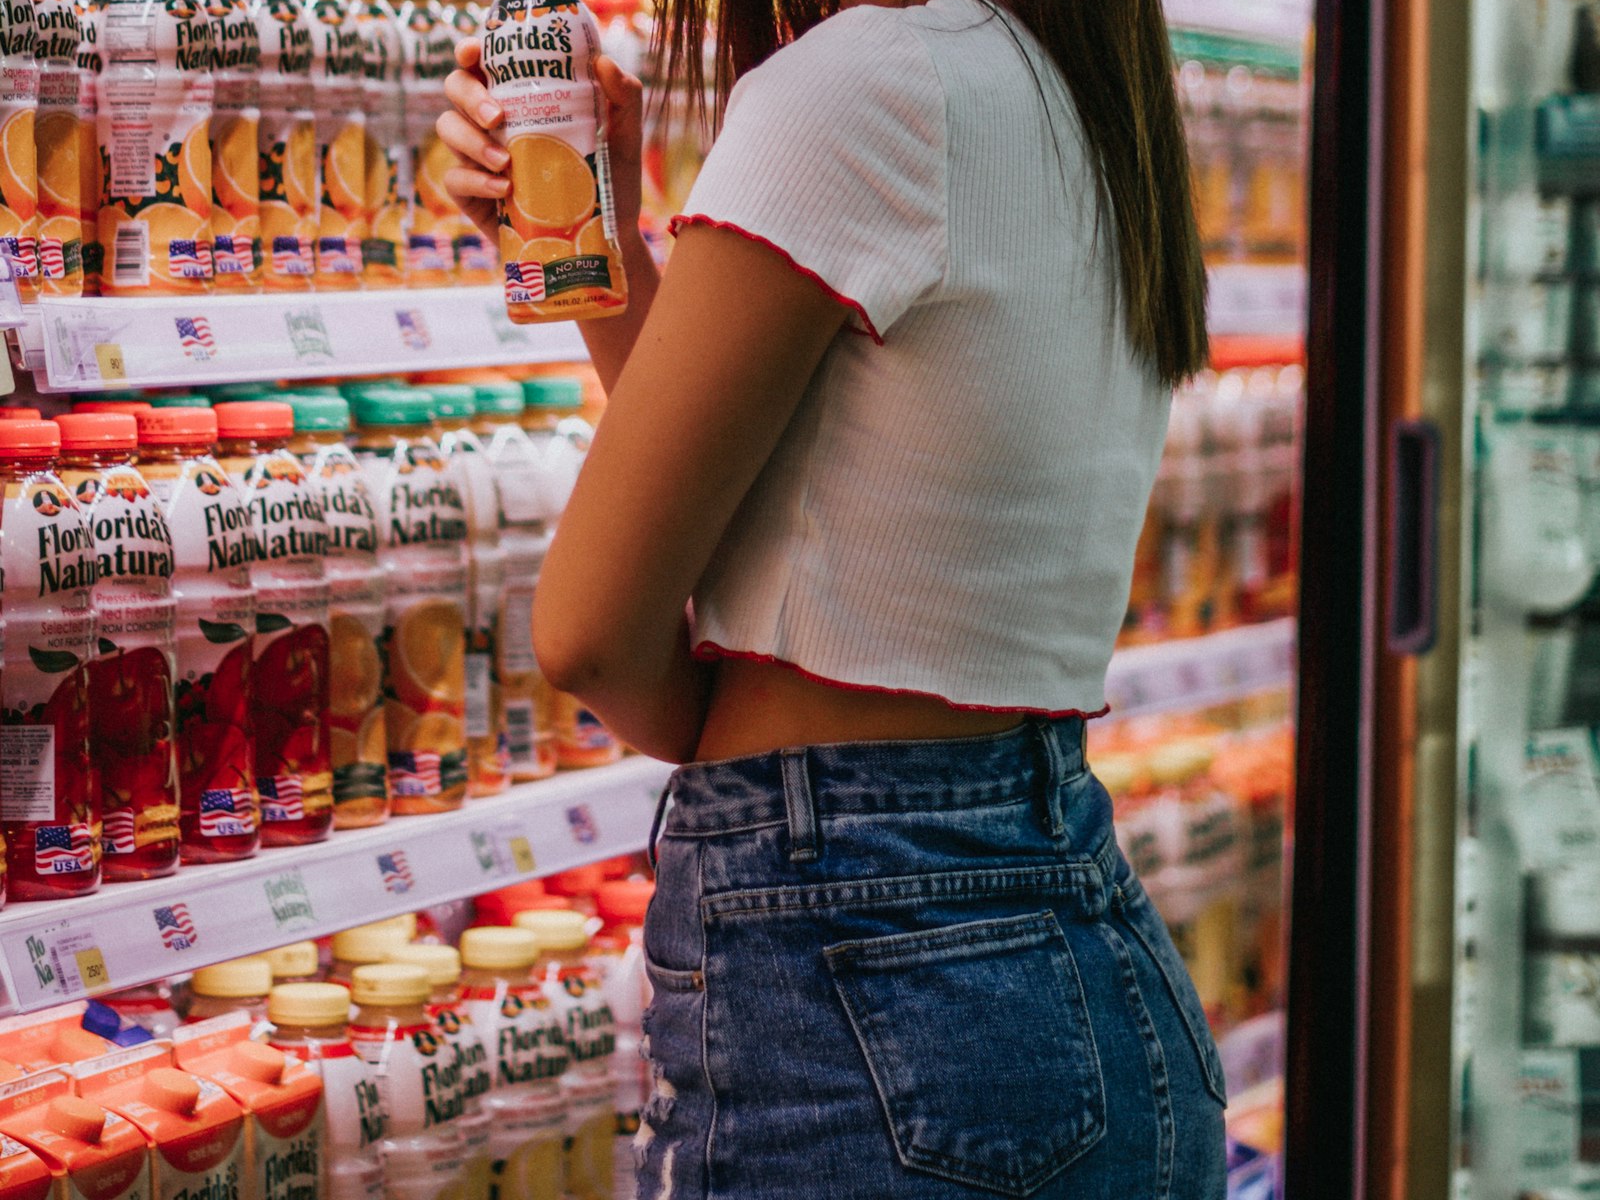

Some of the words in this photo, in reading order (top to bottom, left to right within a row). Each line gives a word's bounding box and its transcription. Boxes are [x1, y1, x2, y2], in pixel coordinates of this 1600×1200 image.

[506, 0, 521, 9] NO
[484, 24, 573, 62] Florida's
[485, 56, 574, 89] Natural
[529, 91, 552, 103] From
[554, 89, 571, 100] Our
[521, 104, 560, 117] Oranges
[523, 115, 573, 127] CONCENTRATE
[183, 266, 206, 278] USA
[219, 260, 243, 273] USA
[556, 262, 573, 275] NO
[575, 259, 600, 270] PULP
[511, 291, 531, 302] USA
[217, 822, 244, 835] USA
[53, 860, 83, 873] USA
[172, 937, 192, 951] USA
[34, 960, 55, 989] Na
